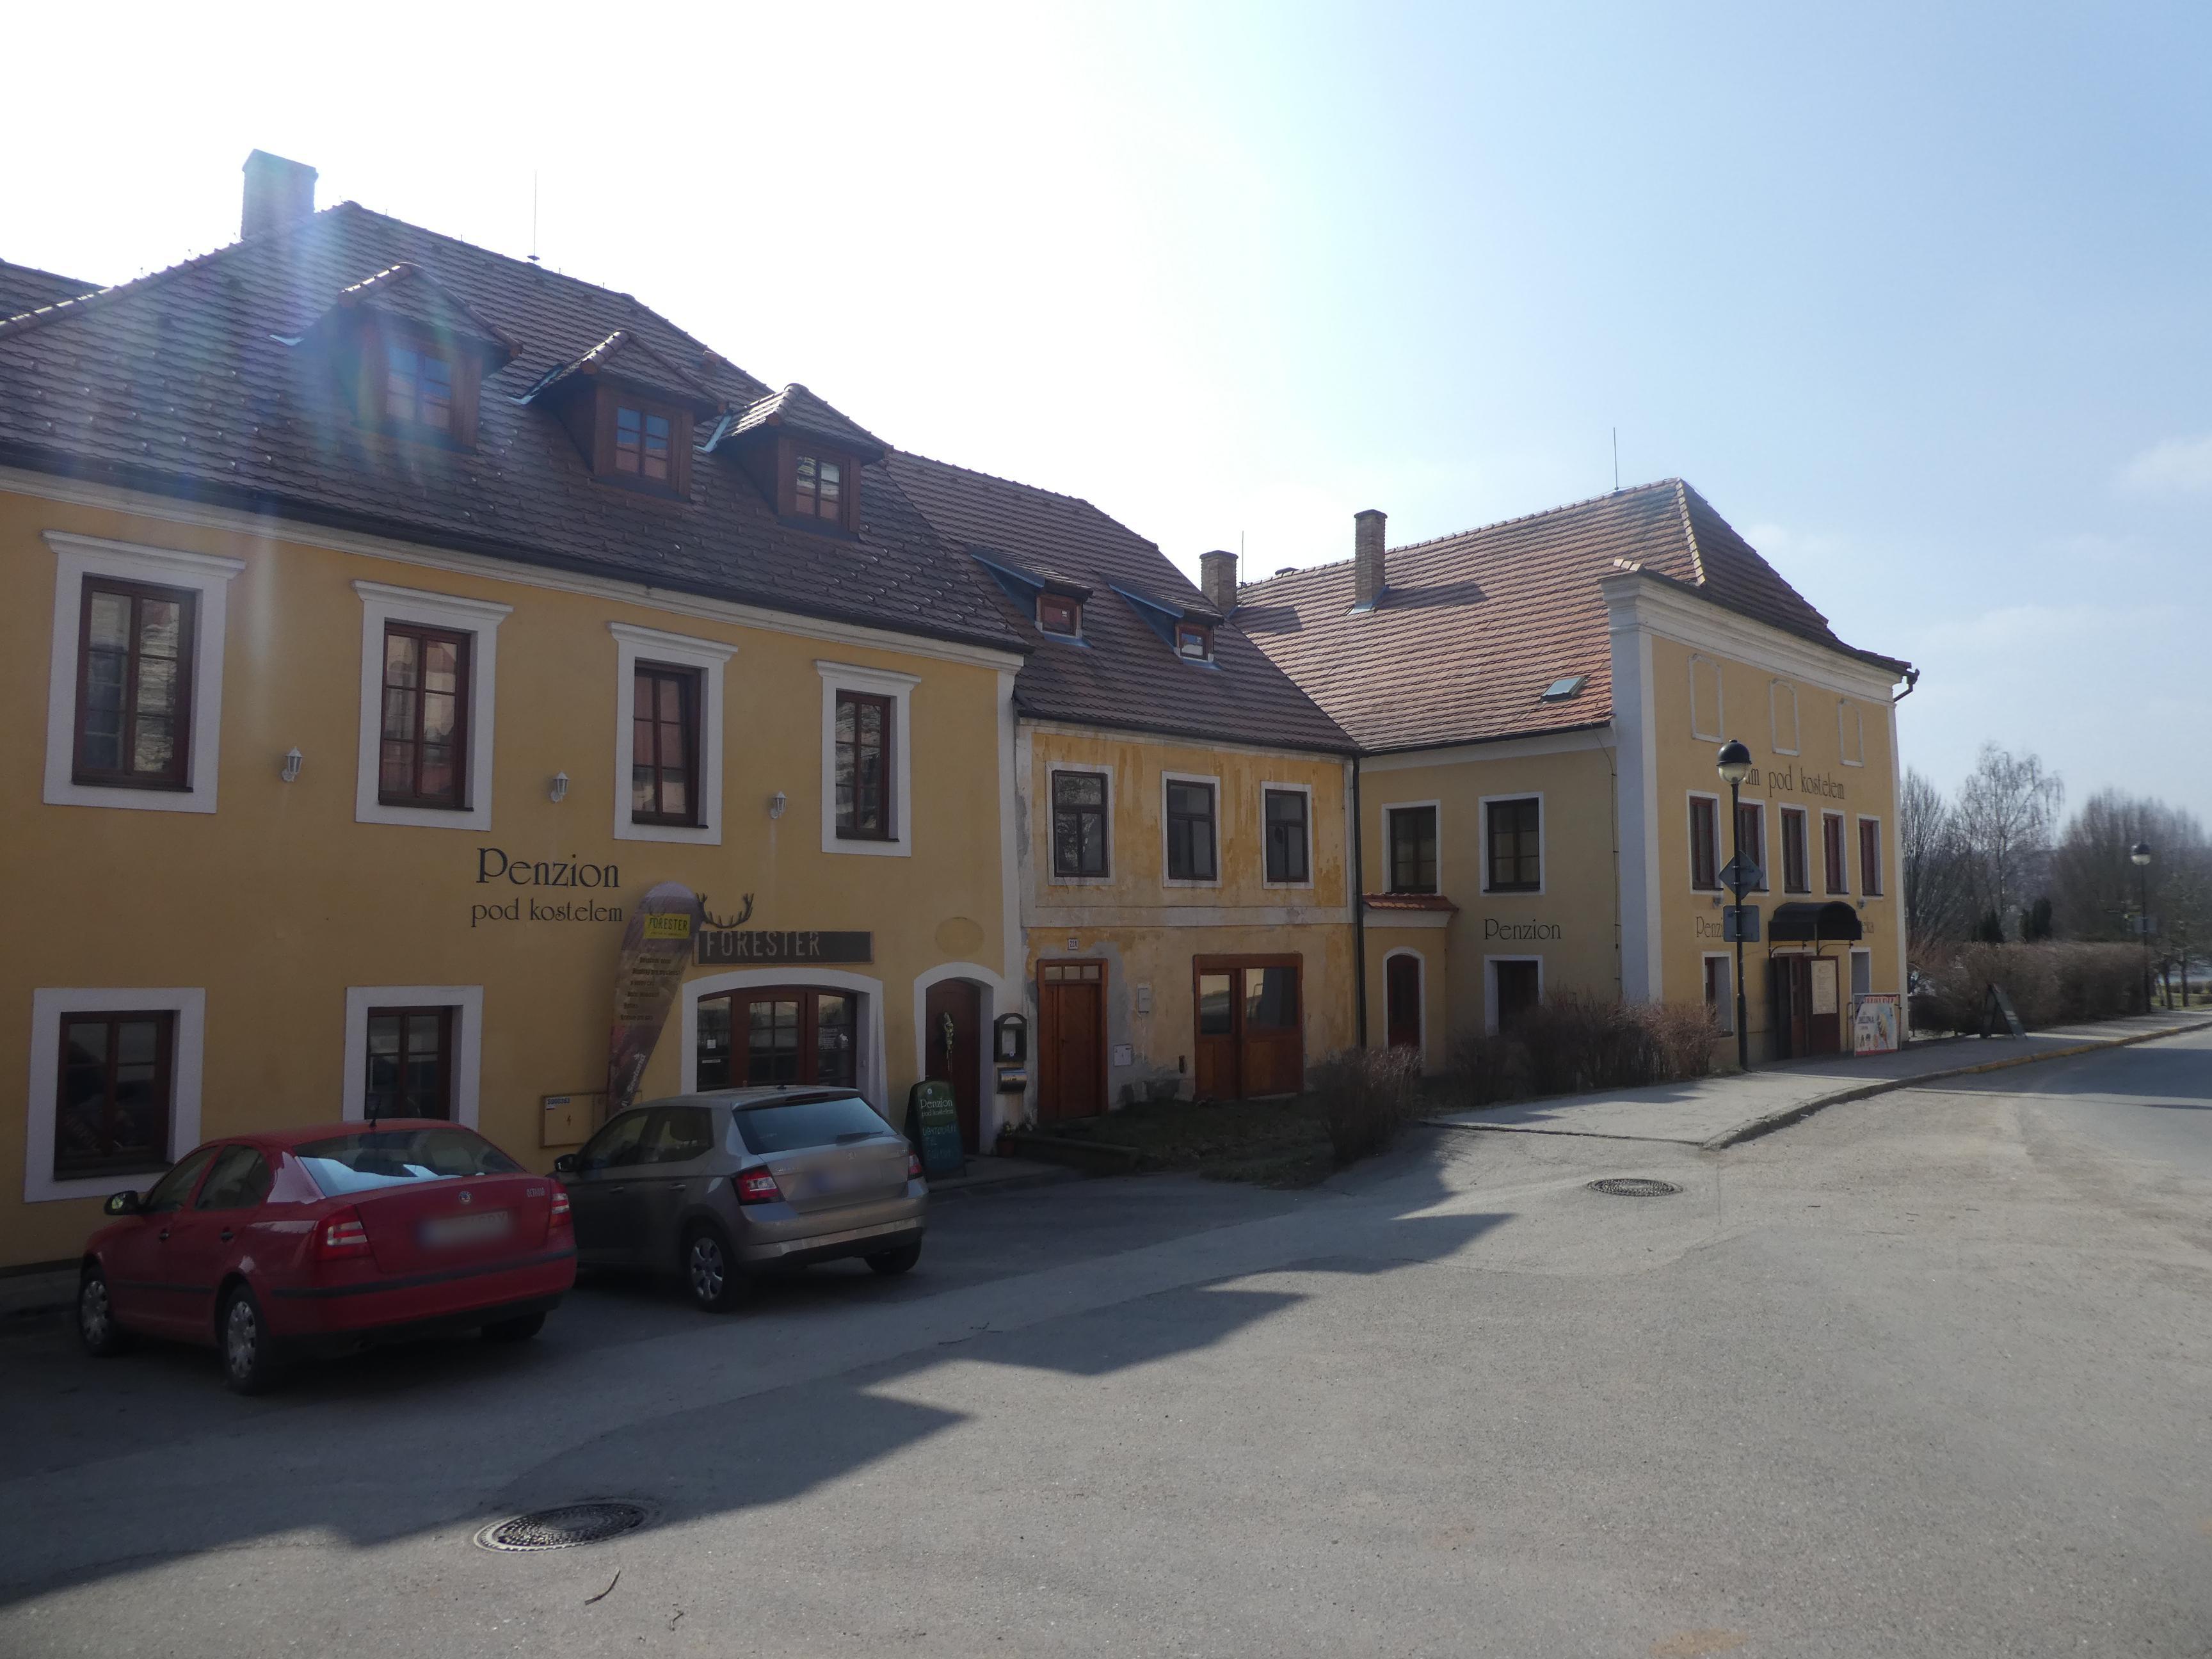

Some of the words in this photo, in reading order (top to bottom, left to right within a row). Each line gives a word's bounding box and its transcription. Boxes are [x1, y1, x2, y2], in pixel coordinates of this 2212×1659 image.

[1768, 764, 1793, 797] pod
[1800, 767, 1845, 799] kostelem
[476, 847, 620, 888] Penzion
[471, 897, 519, 927] pod
[530, 897, 623, 922] kostelem
[648, 917, 688, 931] FORESTER
[1484, 918, 1562, 940] Penzion
[1695, 916, 1724, 937] Penzi
[707, 931, 821, 956] FORESTER
[920, 1098, 953, 1109] Penzion
